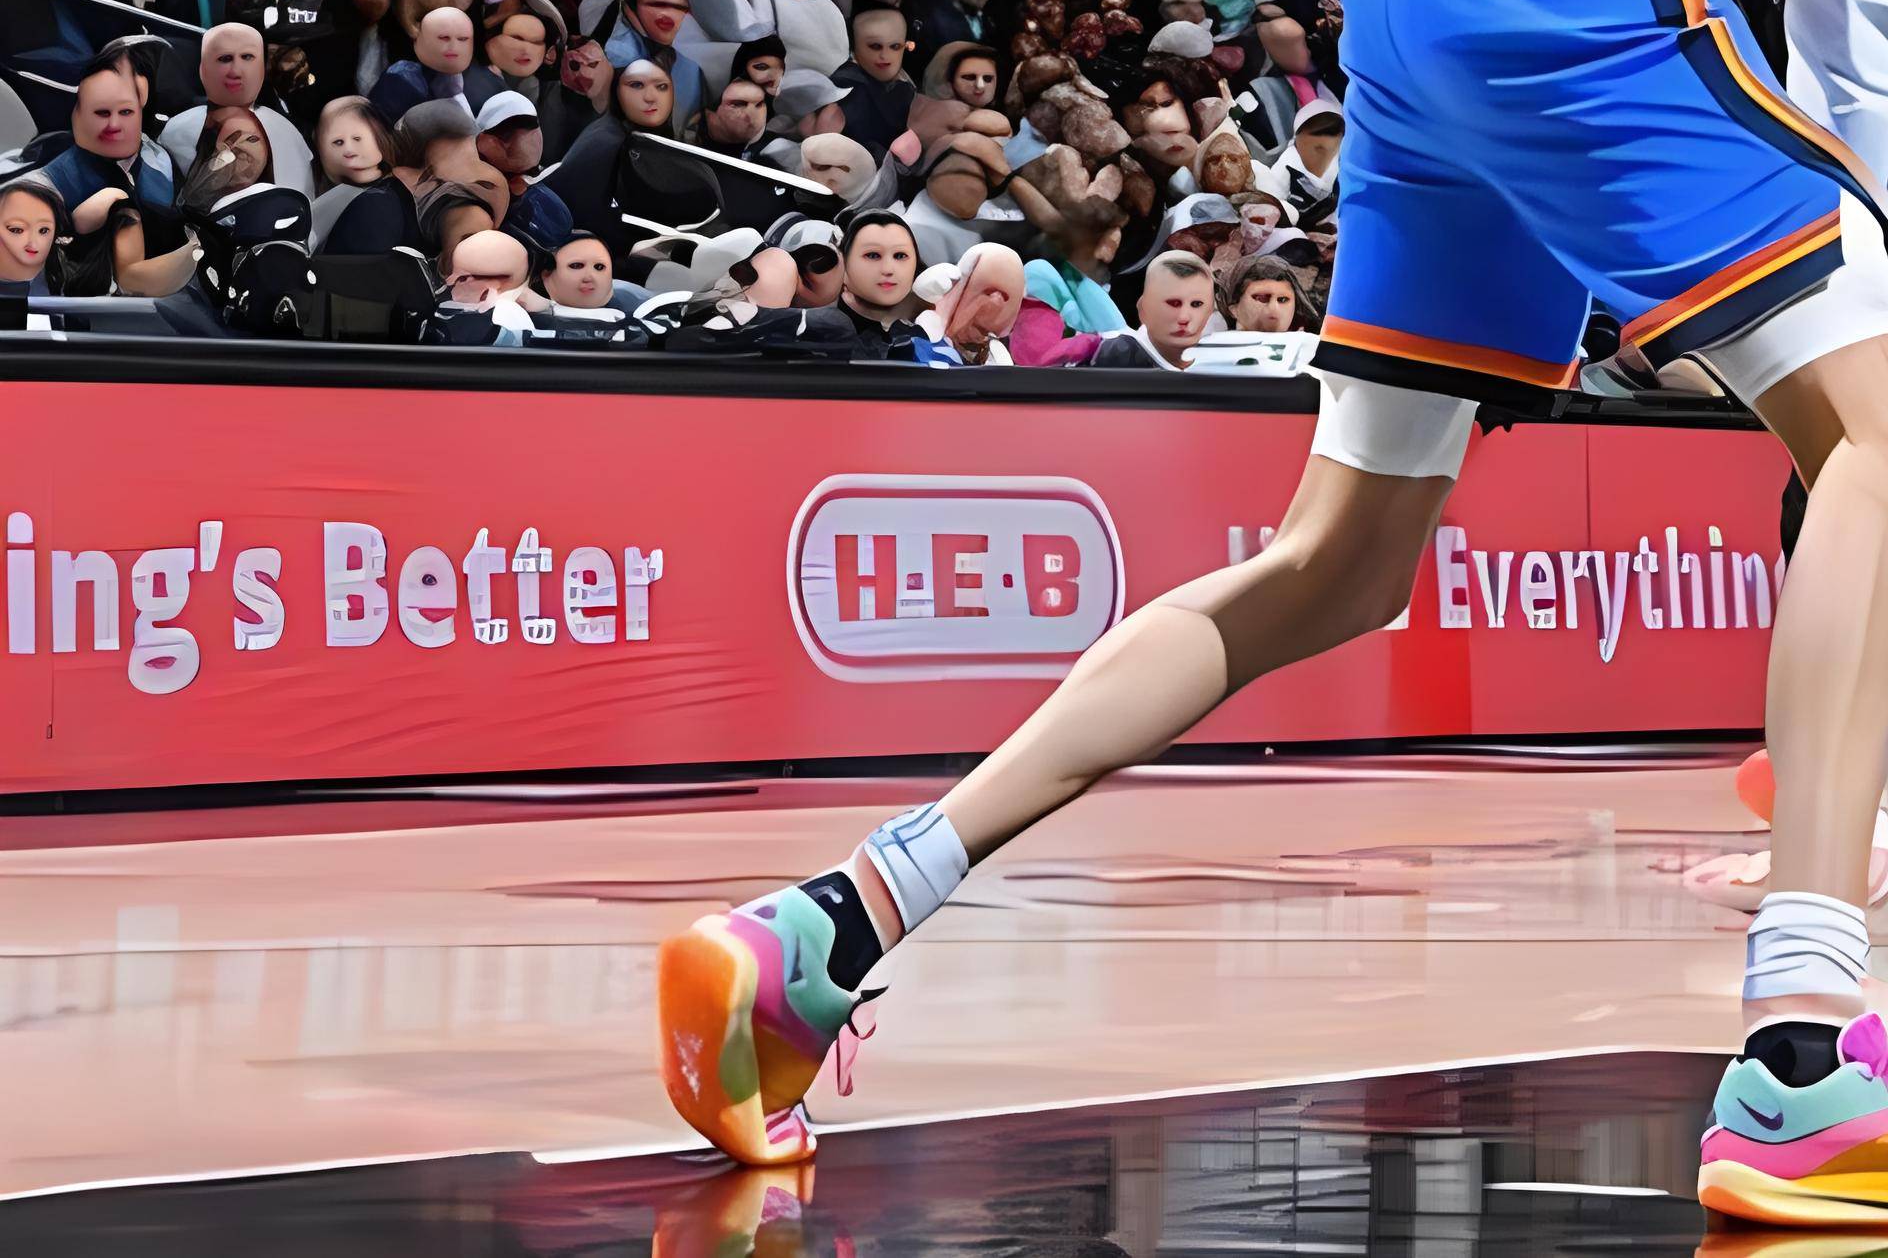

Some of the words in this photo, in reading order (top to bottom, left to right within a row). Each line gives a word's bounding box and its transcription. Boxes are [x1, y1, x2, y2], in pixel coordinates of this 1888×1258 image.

[7, 511, 284, 694] ing's
[323, 521, 664, 648] Better
[1435, 525, 1785, 663] Everythin
